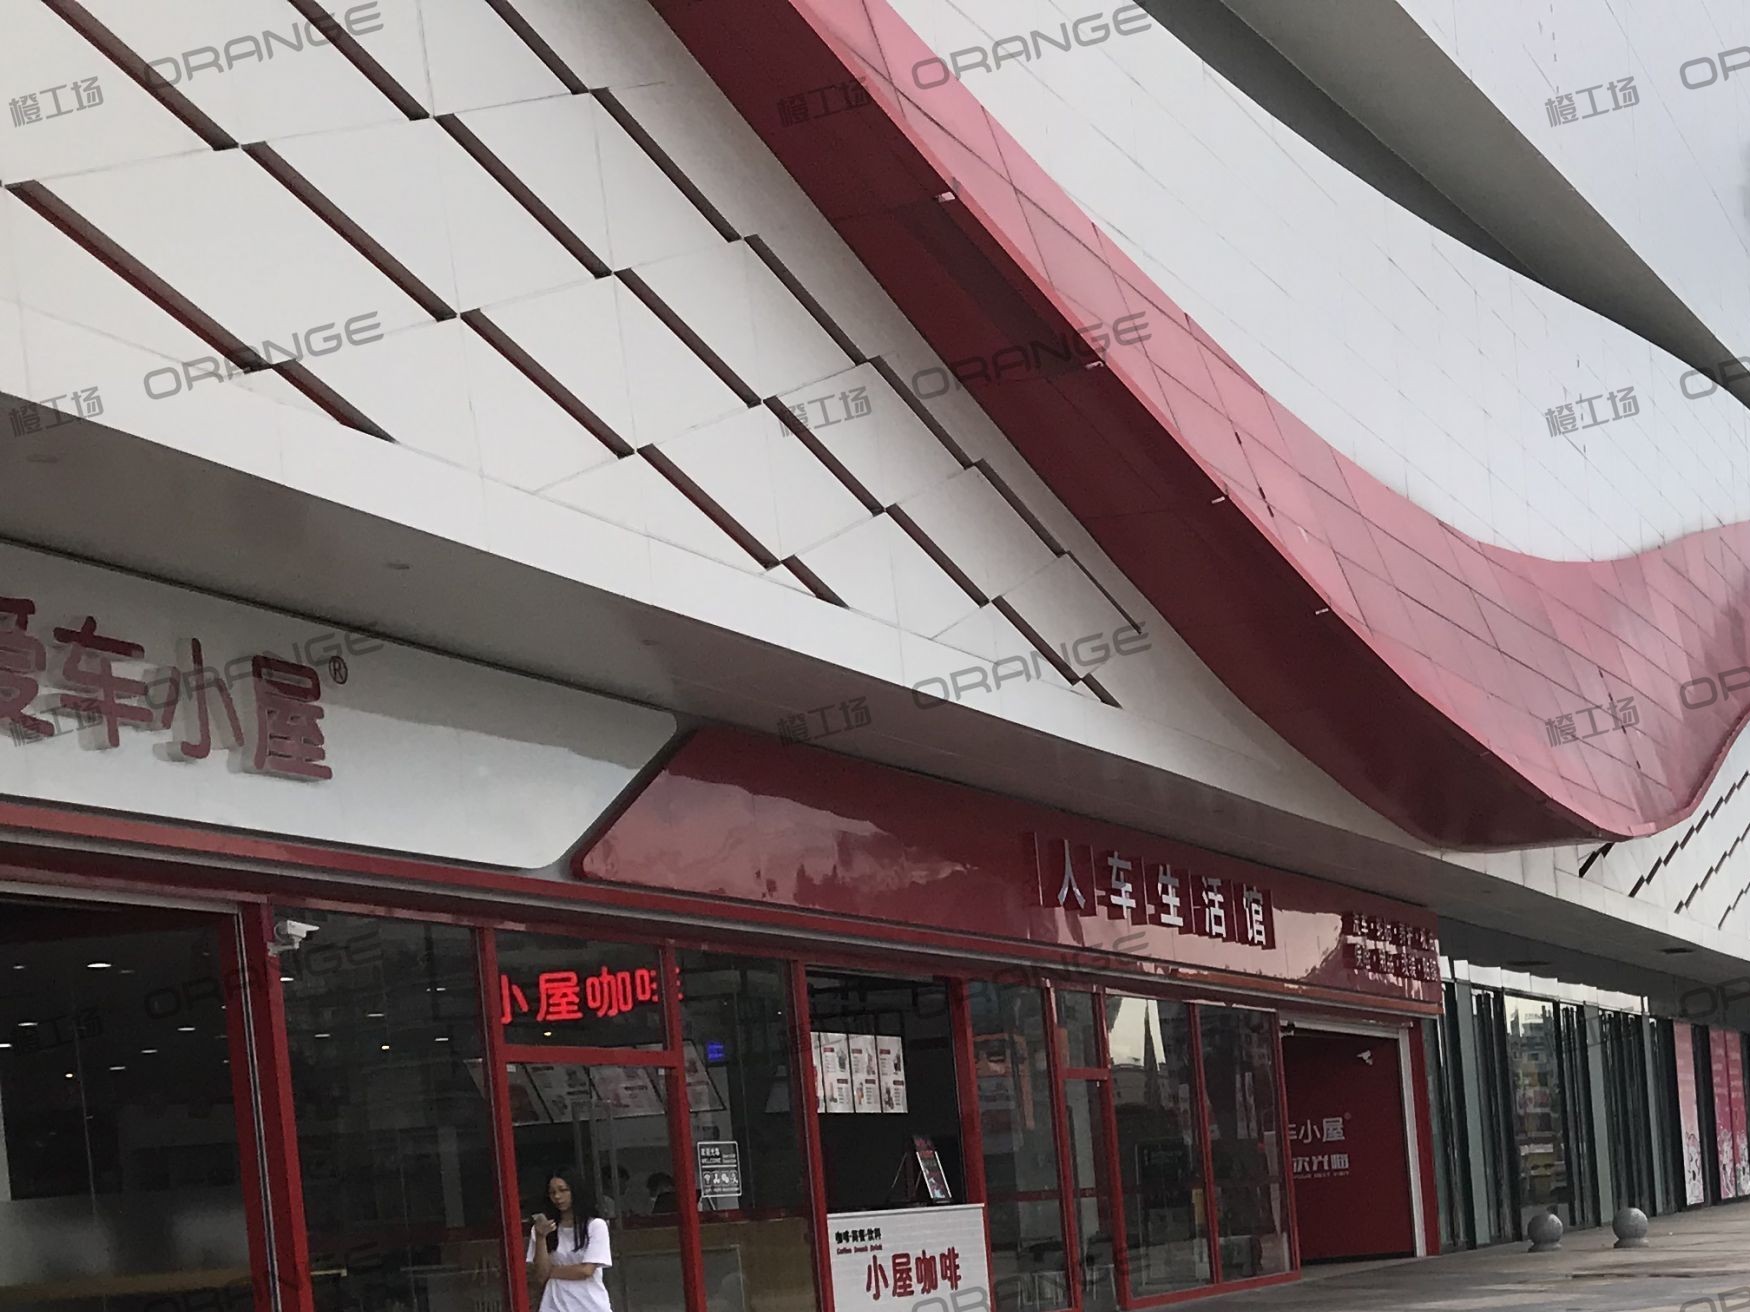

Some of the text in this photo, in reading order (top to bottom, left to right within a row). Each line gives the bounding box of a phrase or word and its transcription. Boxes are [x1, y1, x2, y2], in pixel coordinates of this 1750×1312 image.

[1057, 838, 1268, 947] 人车生活馆
[501, 965, 684, 1025] 小屋咖啡
[866, 1246, 962, 1301] 小屋咖啡
